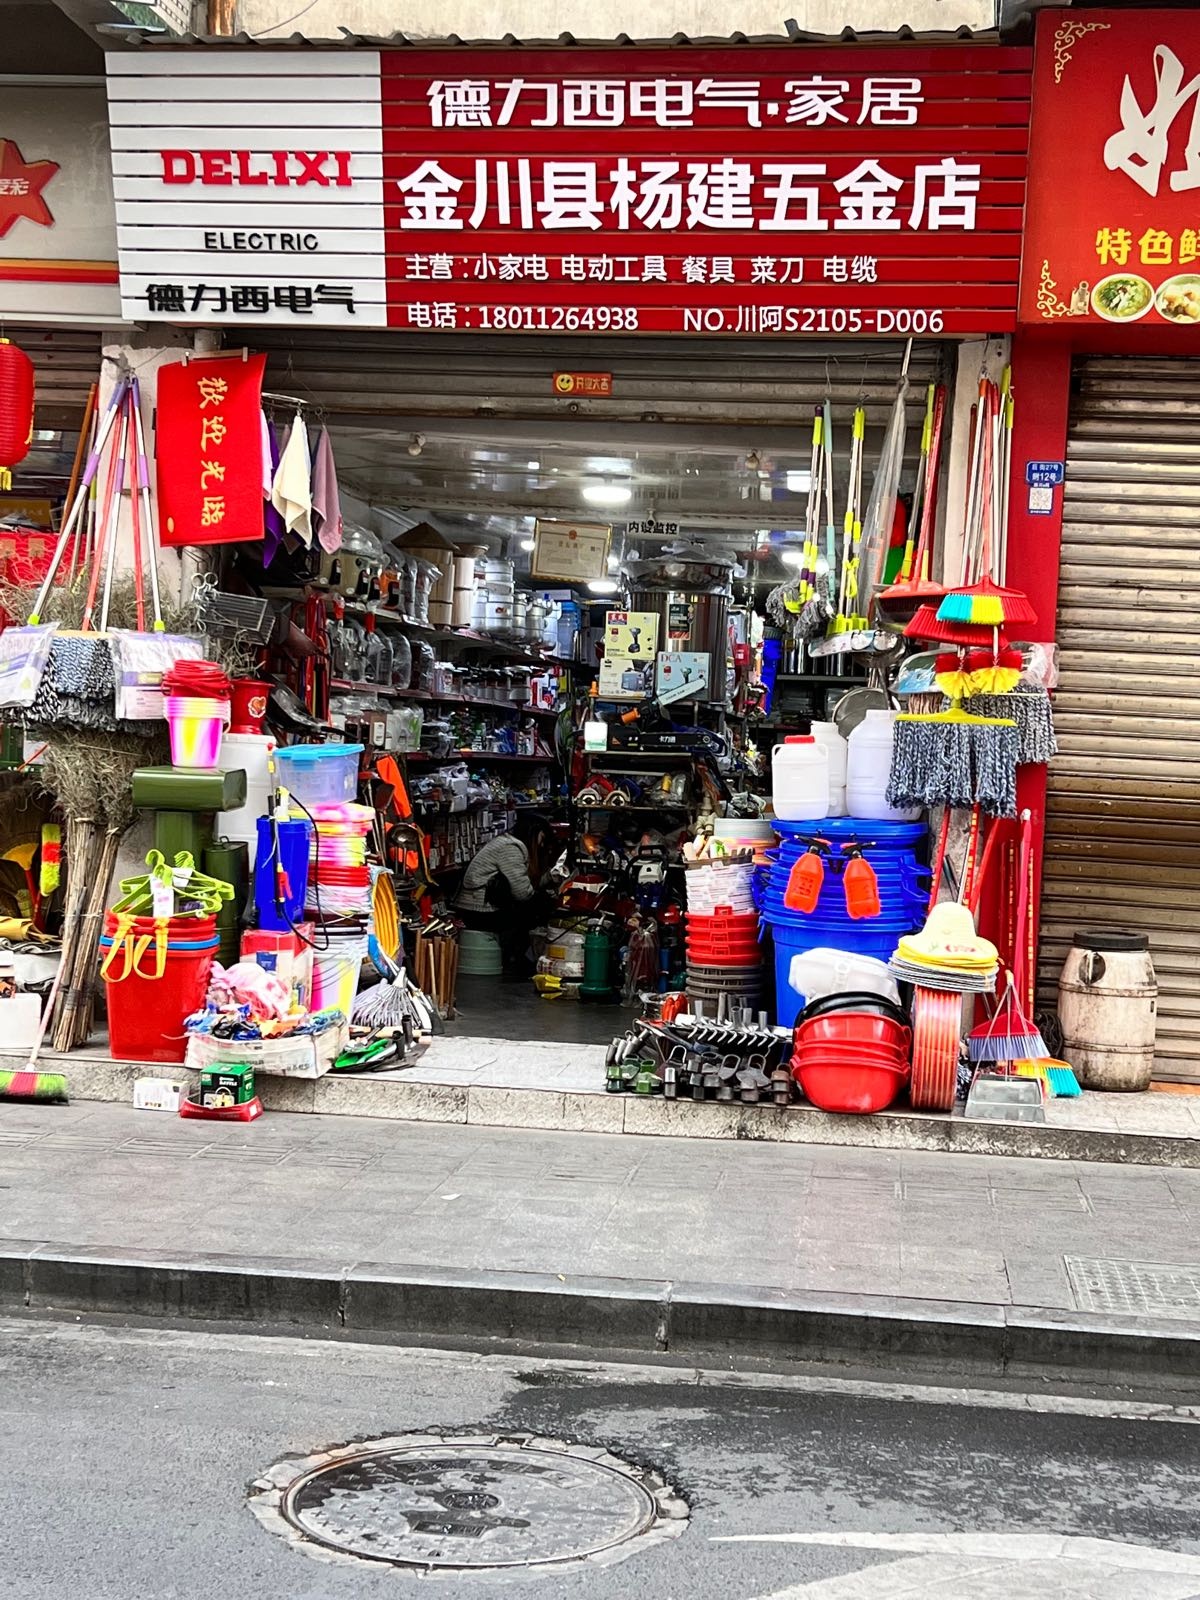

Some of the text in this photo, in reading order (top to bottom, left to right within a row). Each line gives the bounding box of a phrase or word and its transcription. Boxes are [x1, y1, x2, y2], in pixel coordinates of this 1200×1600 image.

[427, 76, 925, 128] 德力西电气·家居
[160, 150, 353, 187] DELIXI
[397, 158, 981, 230] 金川县杨建五金店
[203, 232, 319, 251] ELECTRIC
[560, 254, 668, 282] 电动工具
[681, 256, 736, 283] 餐具
[750, 256, 804, 283] 菜刀
[823, 256, 878, 283] 电缆
[145, 284, 355, 314] 德力西电气
[683, 305, 944, 333] NO.川阿S2105-D006
[628, 521, 678, 534] 内设监控
[660, 654, 682, 663] DCA
